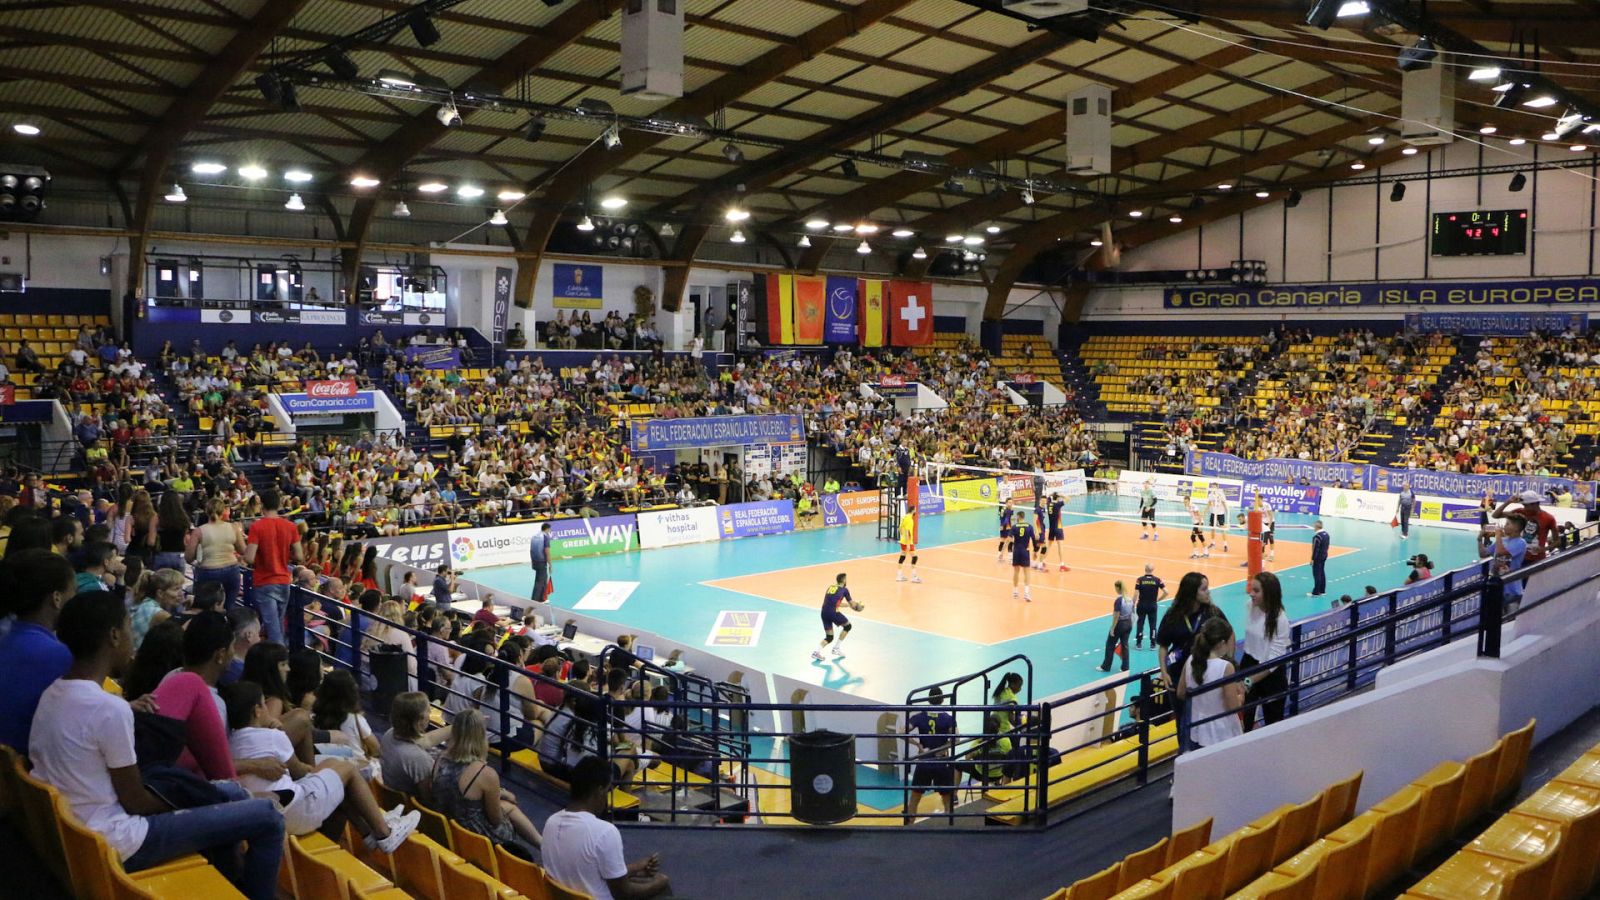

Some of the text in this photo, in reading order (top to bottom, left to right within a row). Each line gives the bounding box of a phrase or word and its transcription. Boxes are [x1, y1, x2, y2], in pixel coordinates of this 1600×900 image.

[1189, 286, 1598, 306] Gran Canaria ISLA EUROPEA
[493, 300, 505, 344] HPS
[1422, 316, 1438, 329] REAL
[1519, 317, 1529, 330] DE
[289, 398, 368, 408] GranCanaria.com
[651, 425, 669, 442] REAL
[714, 419, 748, 439] ESPAÑOLA
[749, 421, 759, 436] DE
[759, 420, 788, 436] VOLEIBOL
[1205, 456, 1221, 472] REAL
[1265, 461, 1300, 479] ESPAÑOLA
[1302, 465, 1312, 480] DE
[1314, 467, 1349, 483] VOLEIBOL
[1512, 480, 1524, 496] DE
[841, 498, 854, 507] 2017
[1270, 496, 1296, 505] 2017
[665, 512, 689, 522] vithas
[734, 510, 747, 519] REAL
[826, 516, 838, 524] CEV
[736, 515, 790, 528] ESPAÑOLA DE VOLEIBOL
[667, 522, 698, 534] hospital
[1019, 527, 1025, 537] 9
[562, 539, 590, 549] GREEN
[375, 543, 444, 563] Zeus
[928, 719, 936, 736] 3
